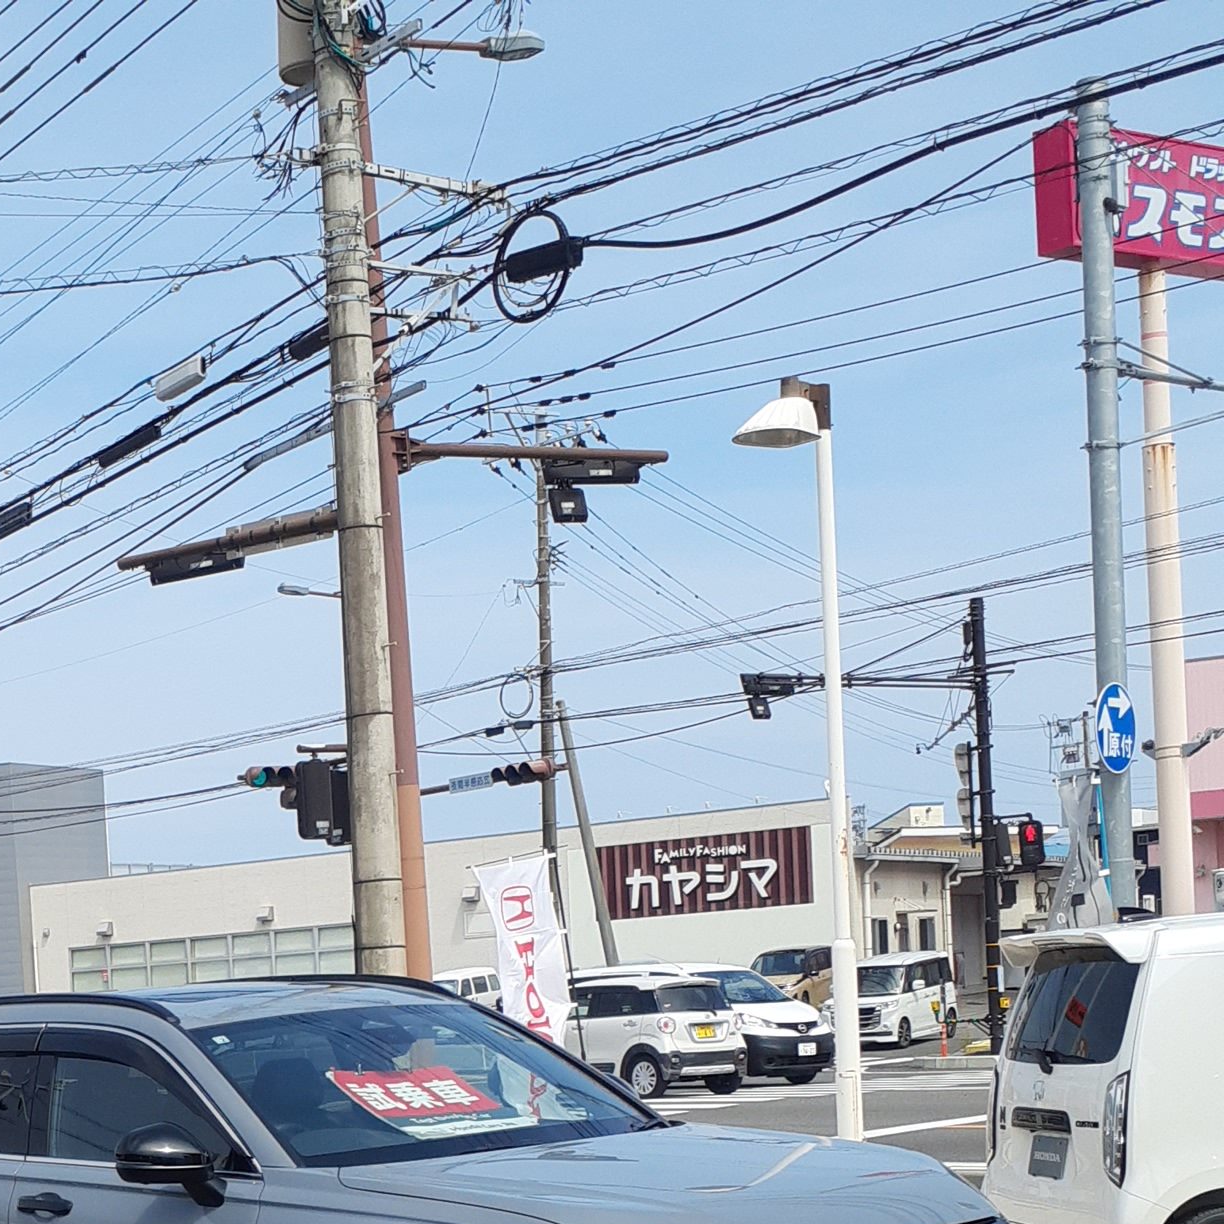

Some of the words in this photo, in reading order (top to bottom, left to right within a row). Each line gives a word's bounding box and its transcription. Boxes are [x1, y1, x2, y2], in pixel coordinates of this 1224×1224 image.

[1108, 733, 1133, 758] 原付
[626, 858, 778, 910] カヤシマ
[346, 1079, 480, 1111] 試乗車
[1034, 1151, 1061, 1163] HONDA
